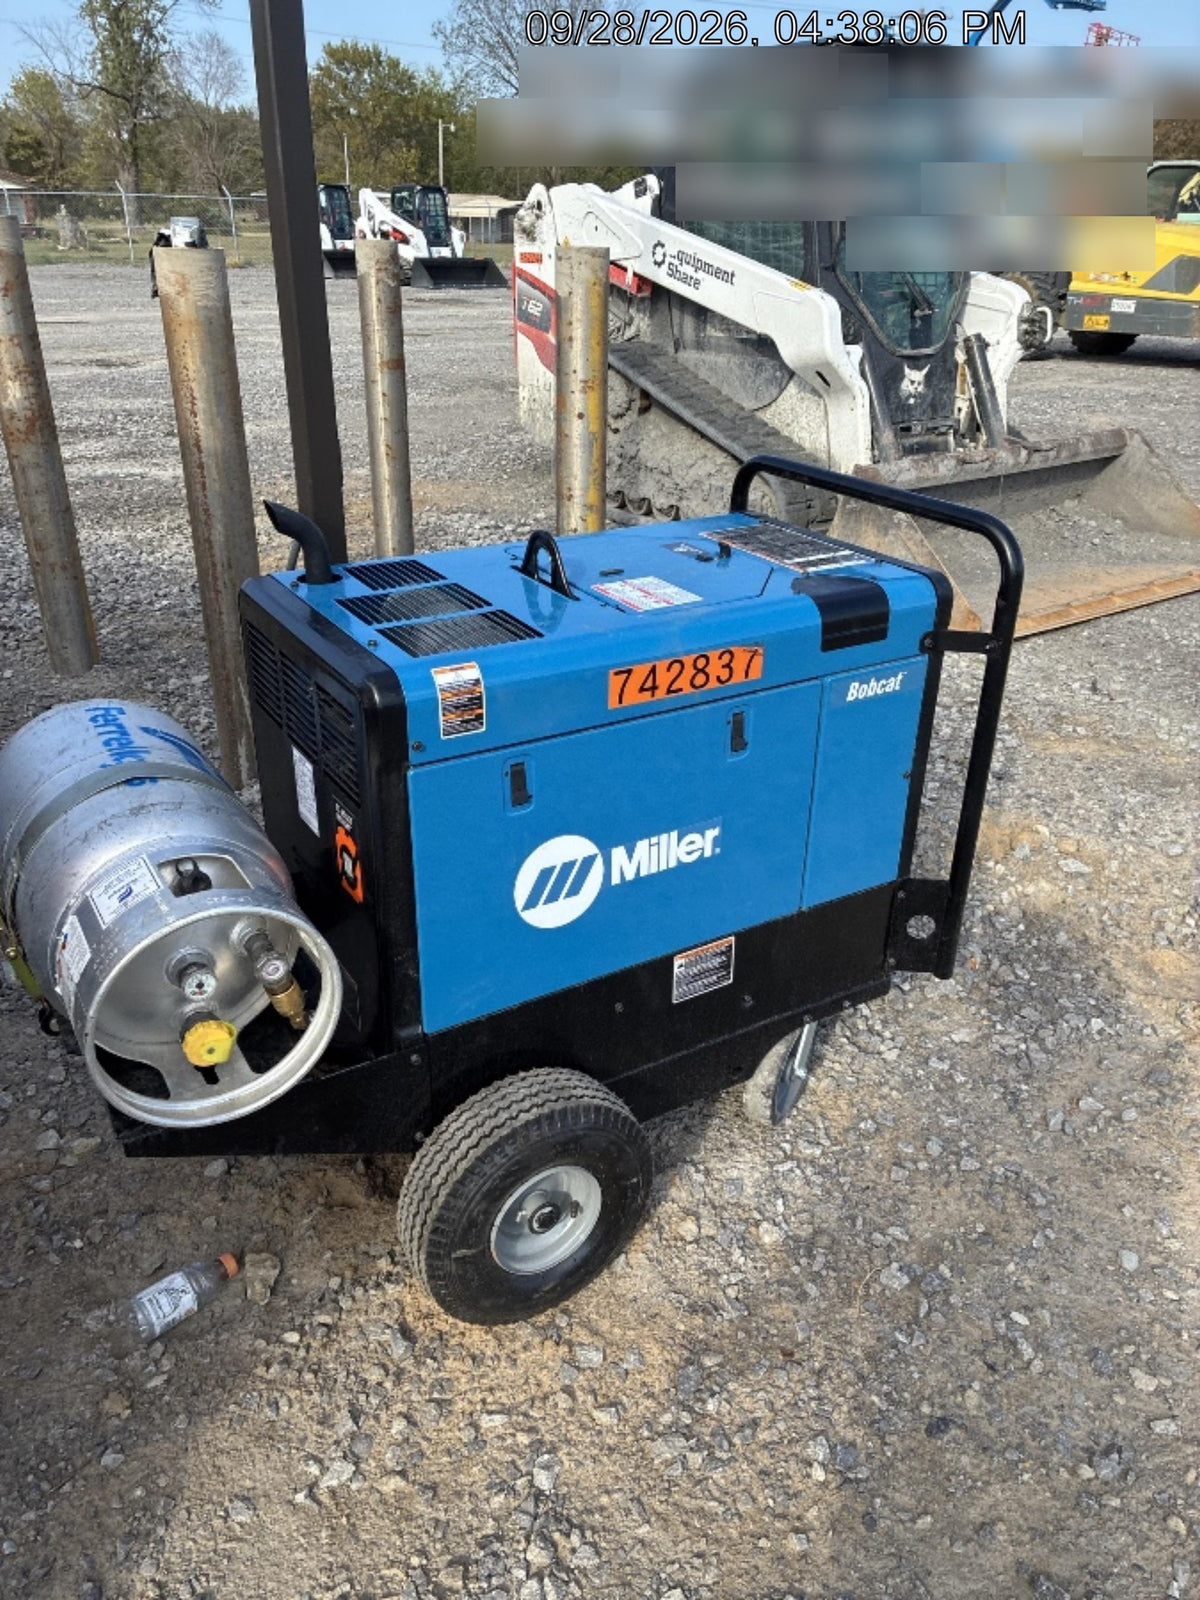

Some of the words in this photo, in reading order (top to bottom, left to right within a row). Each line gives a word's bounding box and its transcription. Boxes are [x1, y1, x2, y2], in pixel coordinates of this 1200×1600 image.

[666, 261, 701, 291] Share
[668, 249, 736, 287] quipment
[612, 648, 764, 706] 742837
[846, 672, 905, 702] Bobcat
[610, 826, 720, 886] Miller
